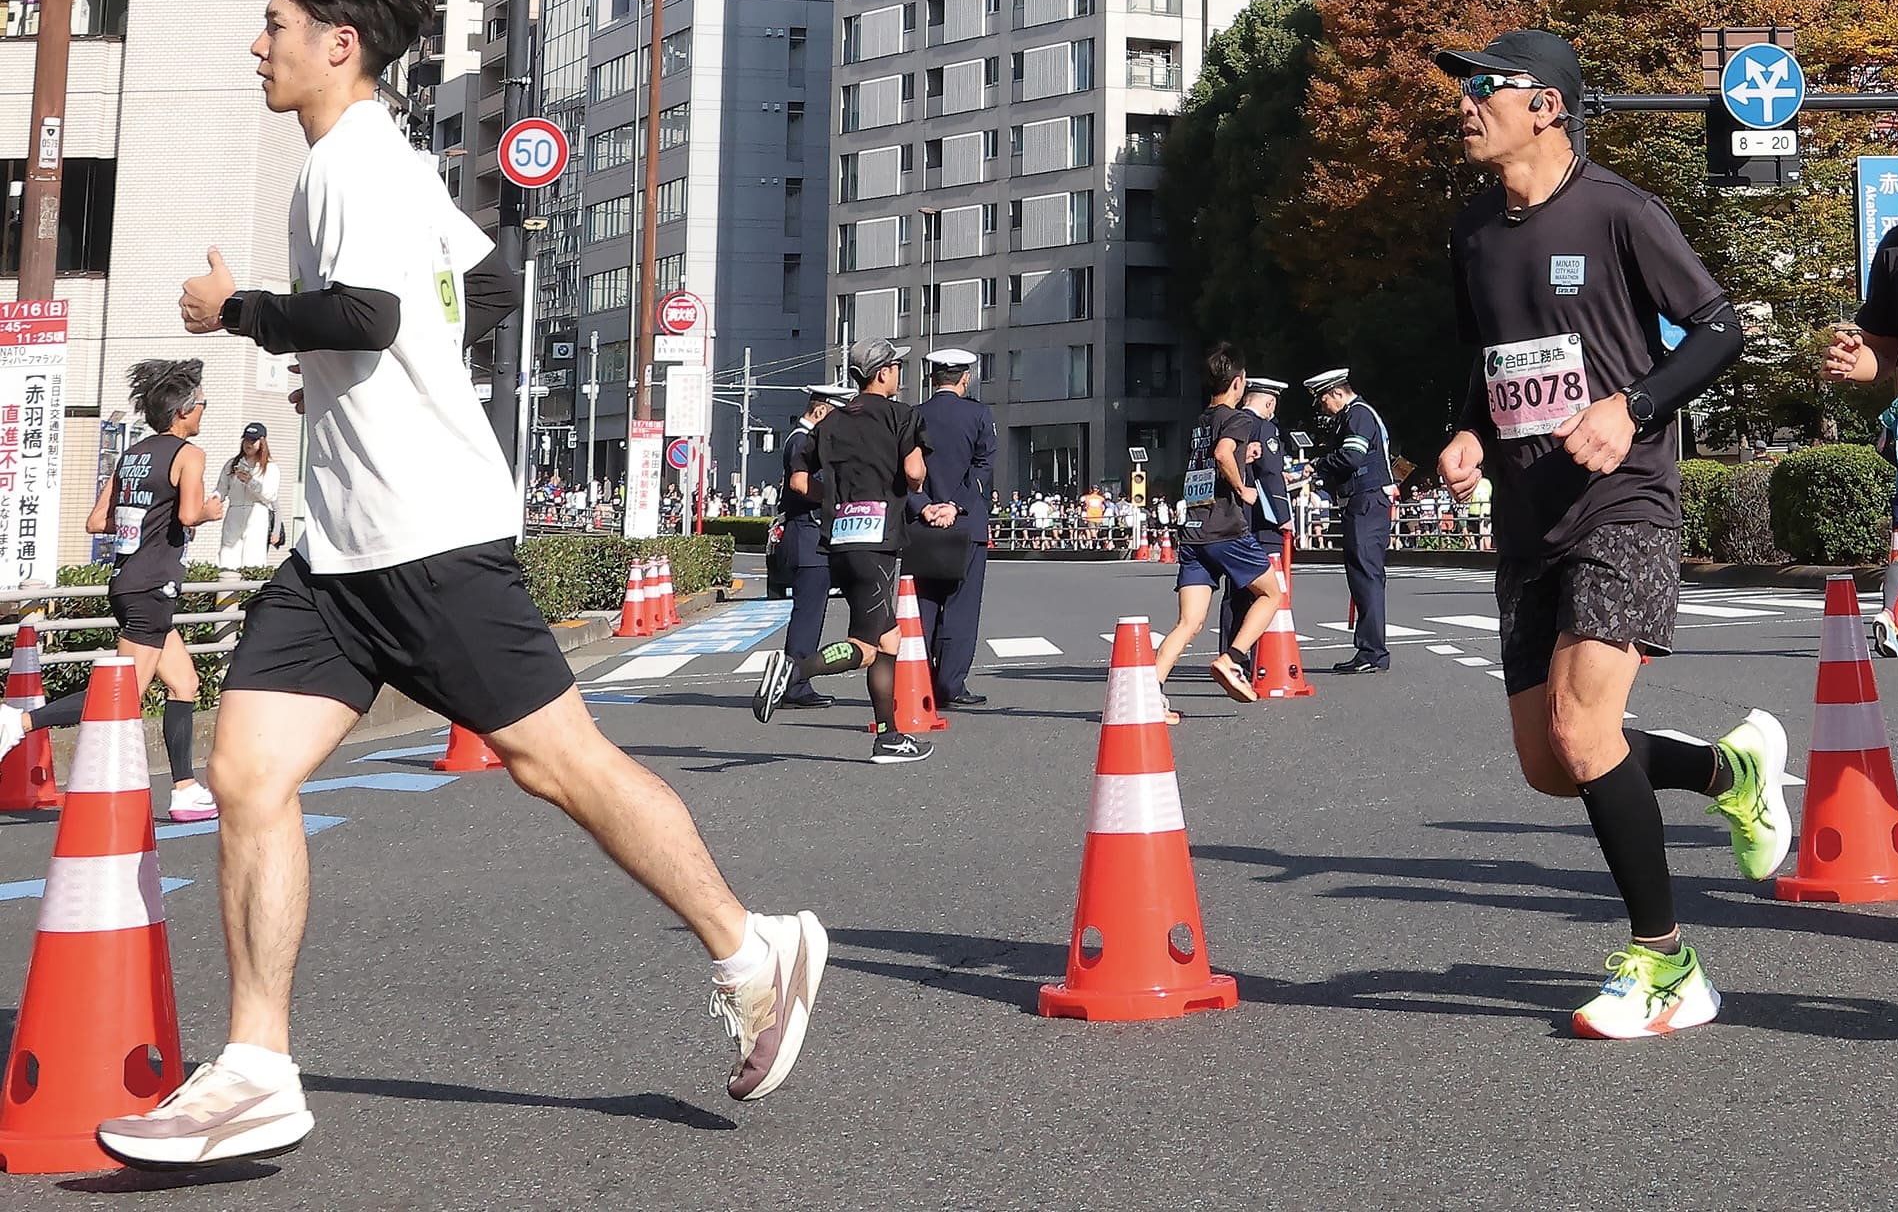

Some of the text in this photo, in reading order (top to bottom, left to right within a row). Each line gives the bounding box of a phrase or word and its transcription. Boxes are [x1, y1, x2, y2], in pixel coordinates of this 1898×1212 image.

[1739, 138, 1748, 150] 8
[1772, 137, 1789, 150] 20
[514, 138, 552, 168] 50
[1505, 348, 1566, 369] 合田工務店
[1496, 371, 1584, 412] 03078
[1187, 483, 1213, 496] 01672
[841, 517, 881, 531] 01797
